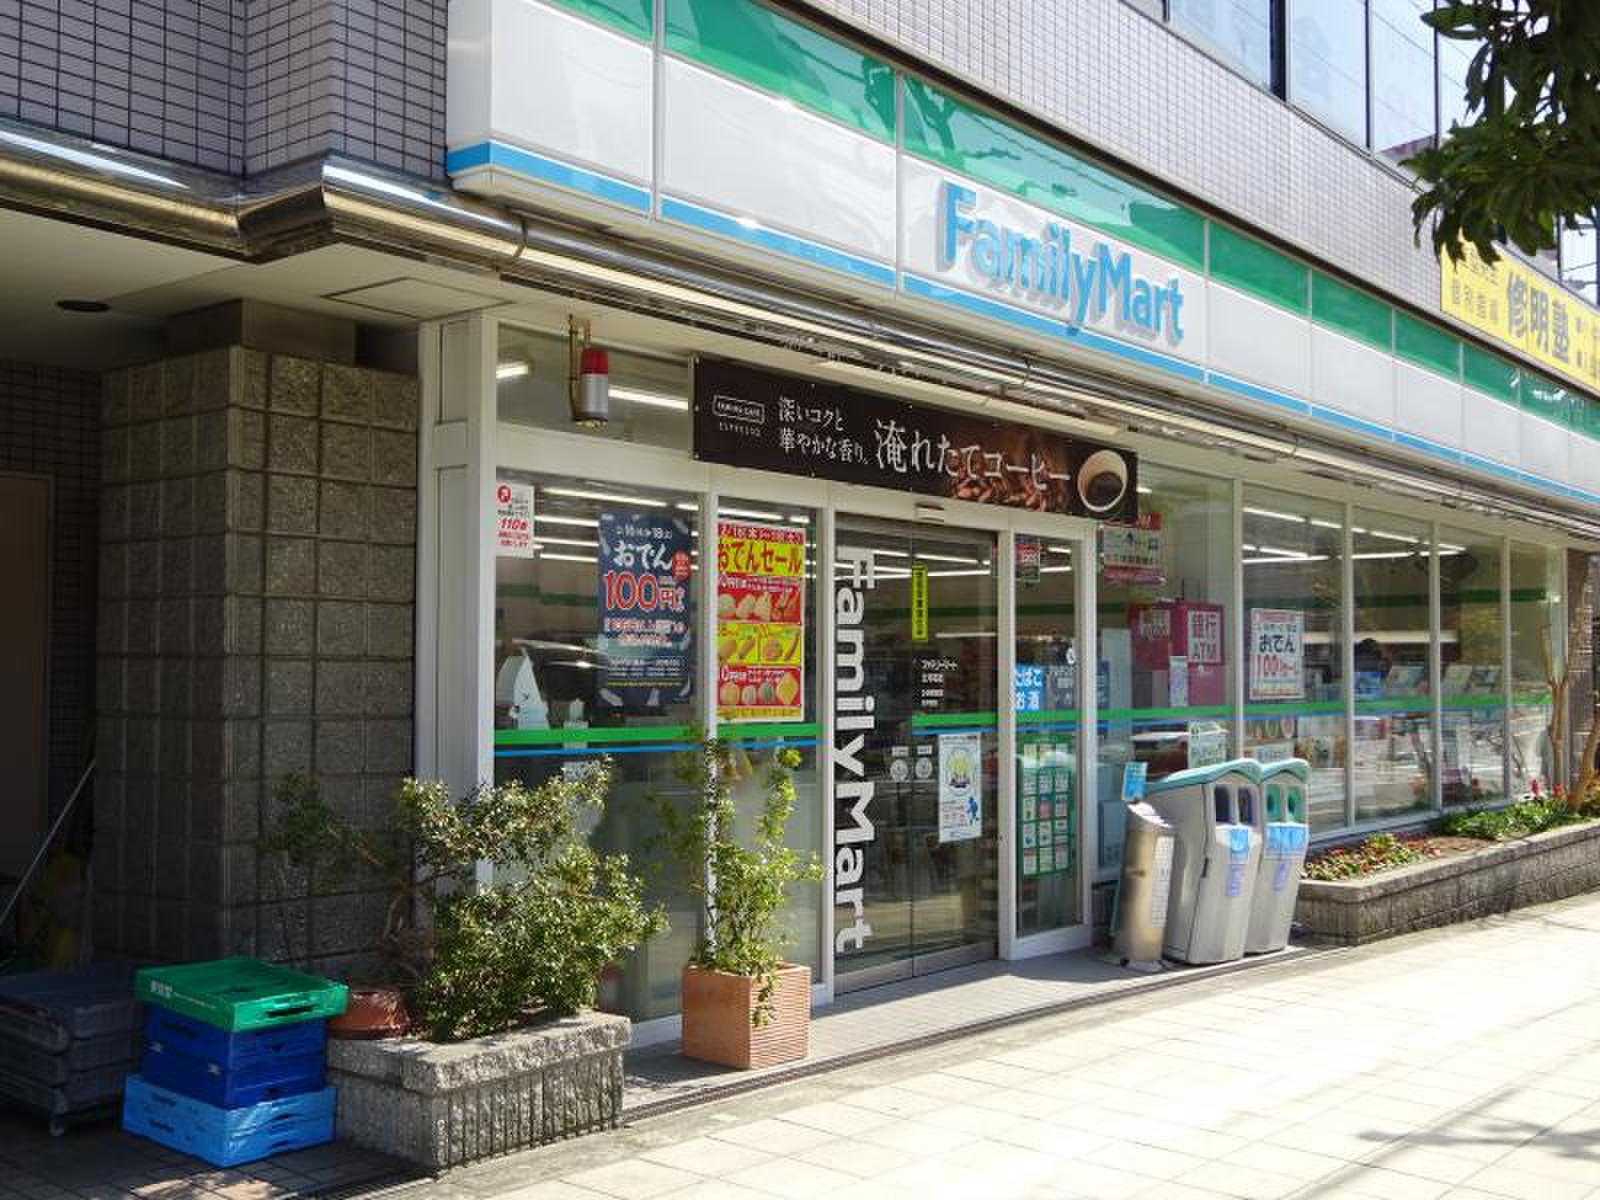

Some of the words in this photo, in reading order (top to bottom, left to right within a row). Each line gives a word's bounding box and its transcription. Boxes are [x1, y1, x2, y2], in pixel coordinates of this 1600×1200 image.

[936, 178, 1185, 347] FamilyMart
[1506, 270, 1569, 365] 修明塾
[778, 395, 845, 433] 深いコクと
[873, 417, 1071, 492] 淹れたてコーヒー
[613, 540, 673, 570] おでん
[717, 539, 802, 574] おでんセール
[1258, 633, 1296, 654] おでん
[833, 544, 876, 954] FamilyMart
